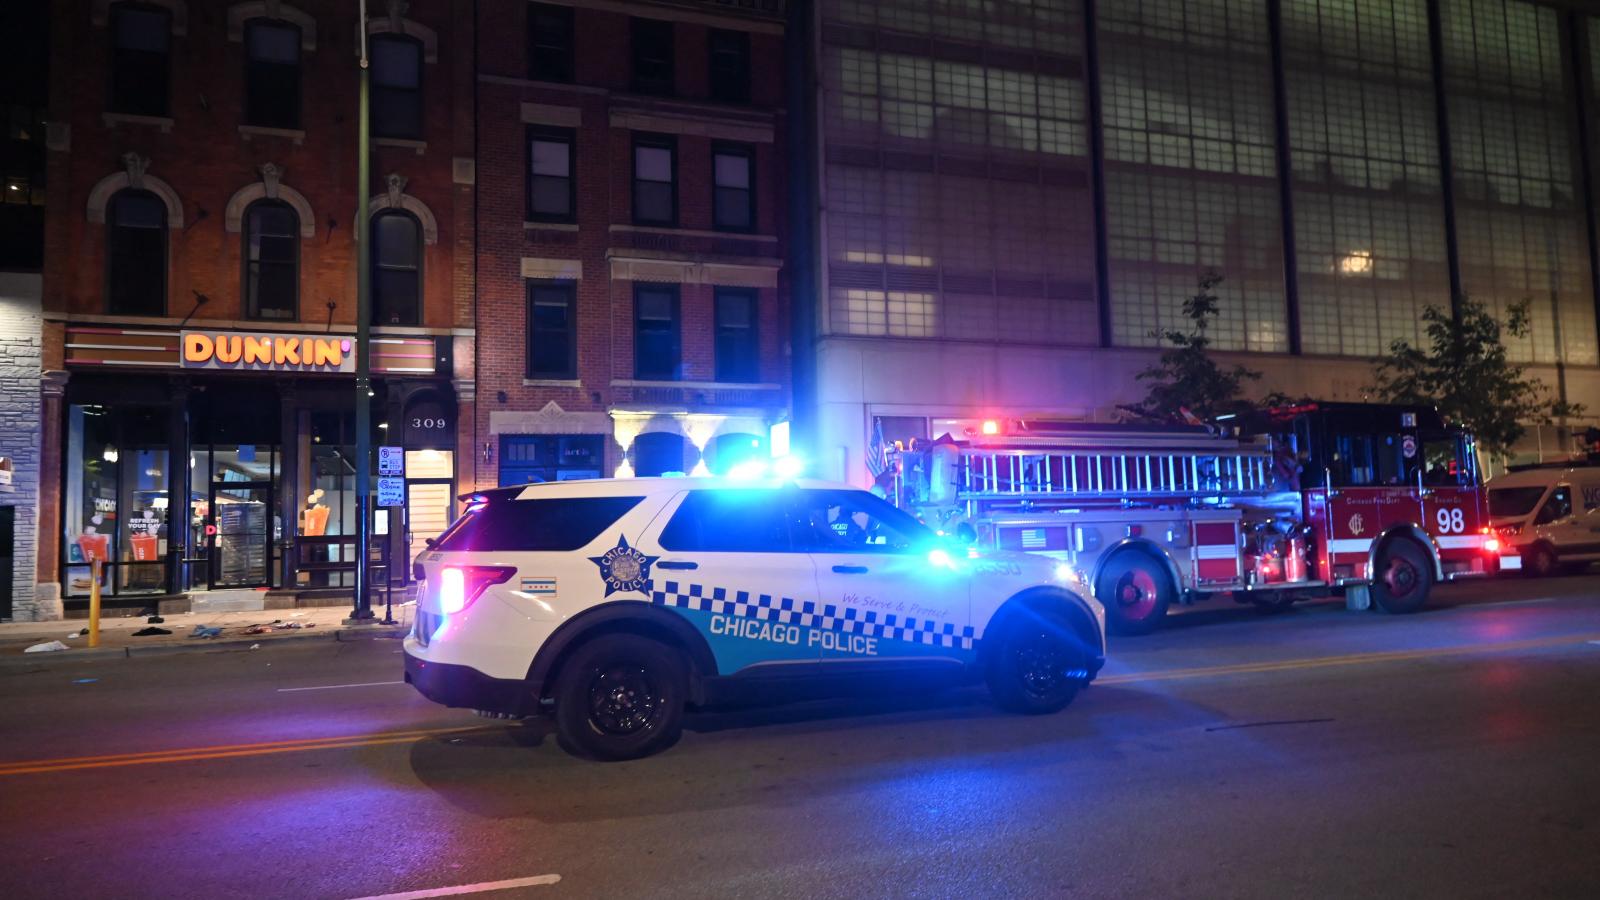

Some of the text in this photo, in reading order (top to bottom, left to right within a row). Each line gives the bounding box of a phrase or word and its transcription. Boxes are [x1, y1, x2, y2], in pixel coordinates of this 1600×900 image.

[184, 334, 350, 367] DUNKIN'
[412, 418, 446, 429] 309
[1437, 508, 1464, 533] 98
[601, 547, 647, 566] CHICAGO
[605, 575, 647, 591] POLICE
[842, 592, 860, 604] We
[861, 595, 893, 609] Serve
[896, 601, 905, 612] &
[710, 615, 878, 655] CHICAGO POLICE
